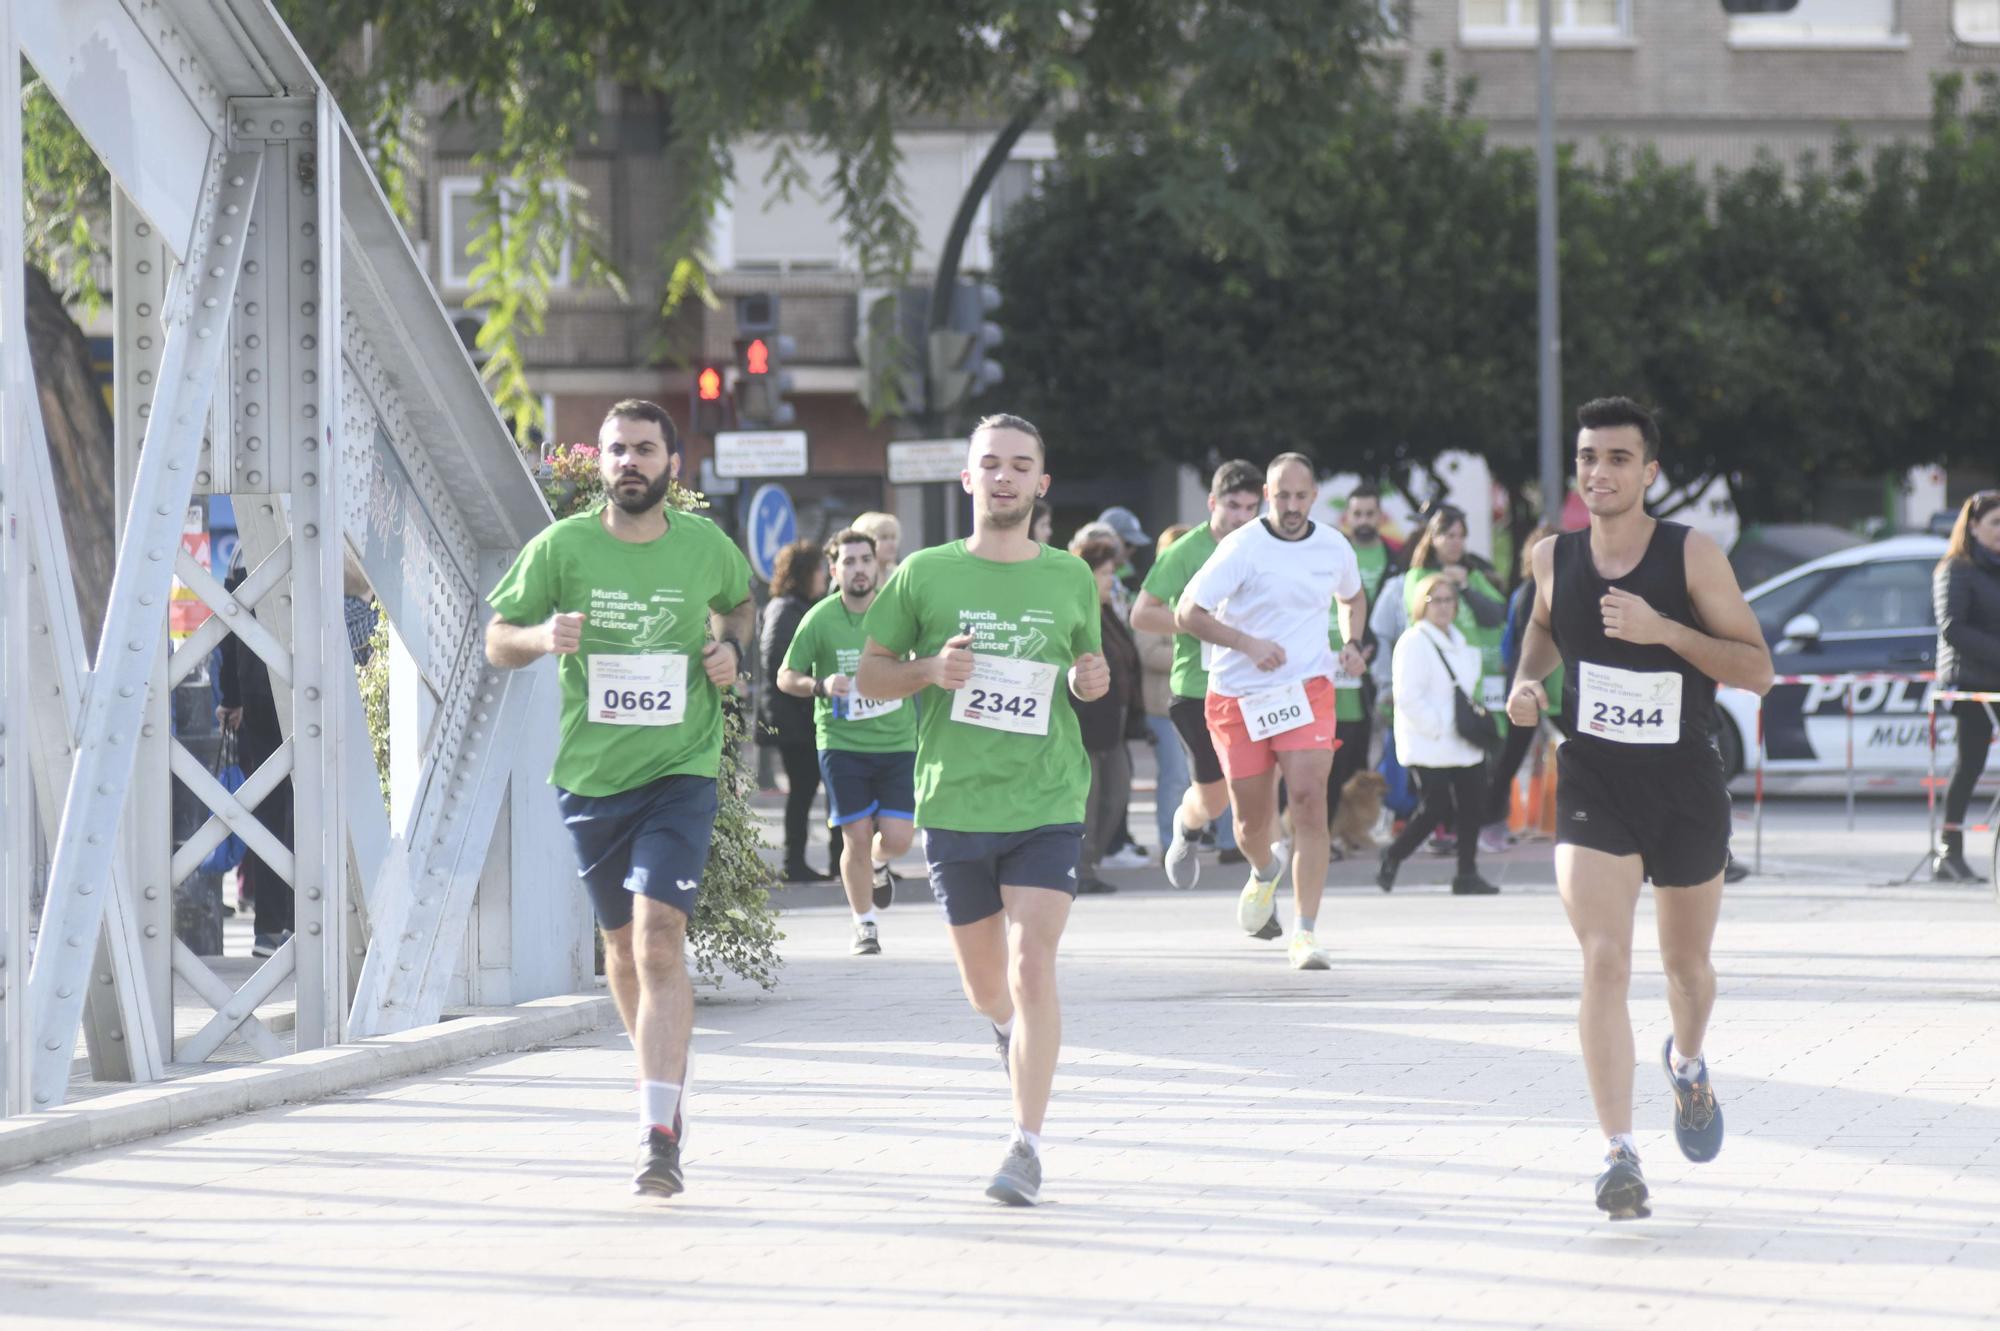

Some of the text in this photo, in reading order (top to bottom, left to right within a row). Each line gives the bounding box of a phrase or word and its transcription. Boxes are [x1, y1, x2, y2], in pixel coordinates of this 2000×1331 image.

[591, 589, 629, 600] Murcia
[590, 600, 647, 611] en marcha
[590, 609, 626, 620] contra
[959, 610, 997, 620] Murcia
[589, 618, 639, 630] el cáncer
[975, 621, 1017, 631] marcha
[975, 631, 995, 640] ntra
[971, 640, 1010, 650] cáncer
[604, 689, 672, 711] 0662
[969, 689, 1037, 718] 2342
[1256, 704, 1301, 728] 1050
[1593, 702, 1664, 728] 2344
[1868, 721, 1959, 747] MURC
